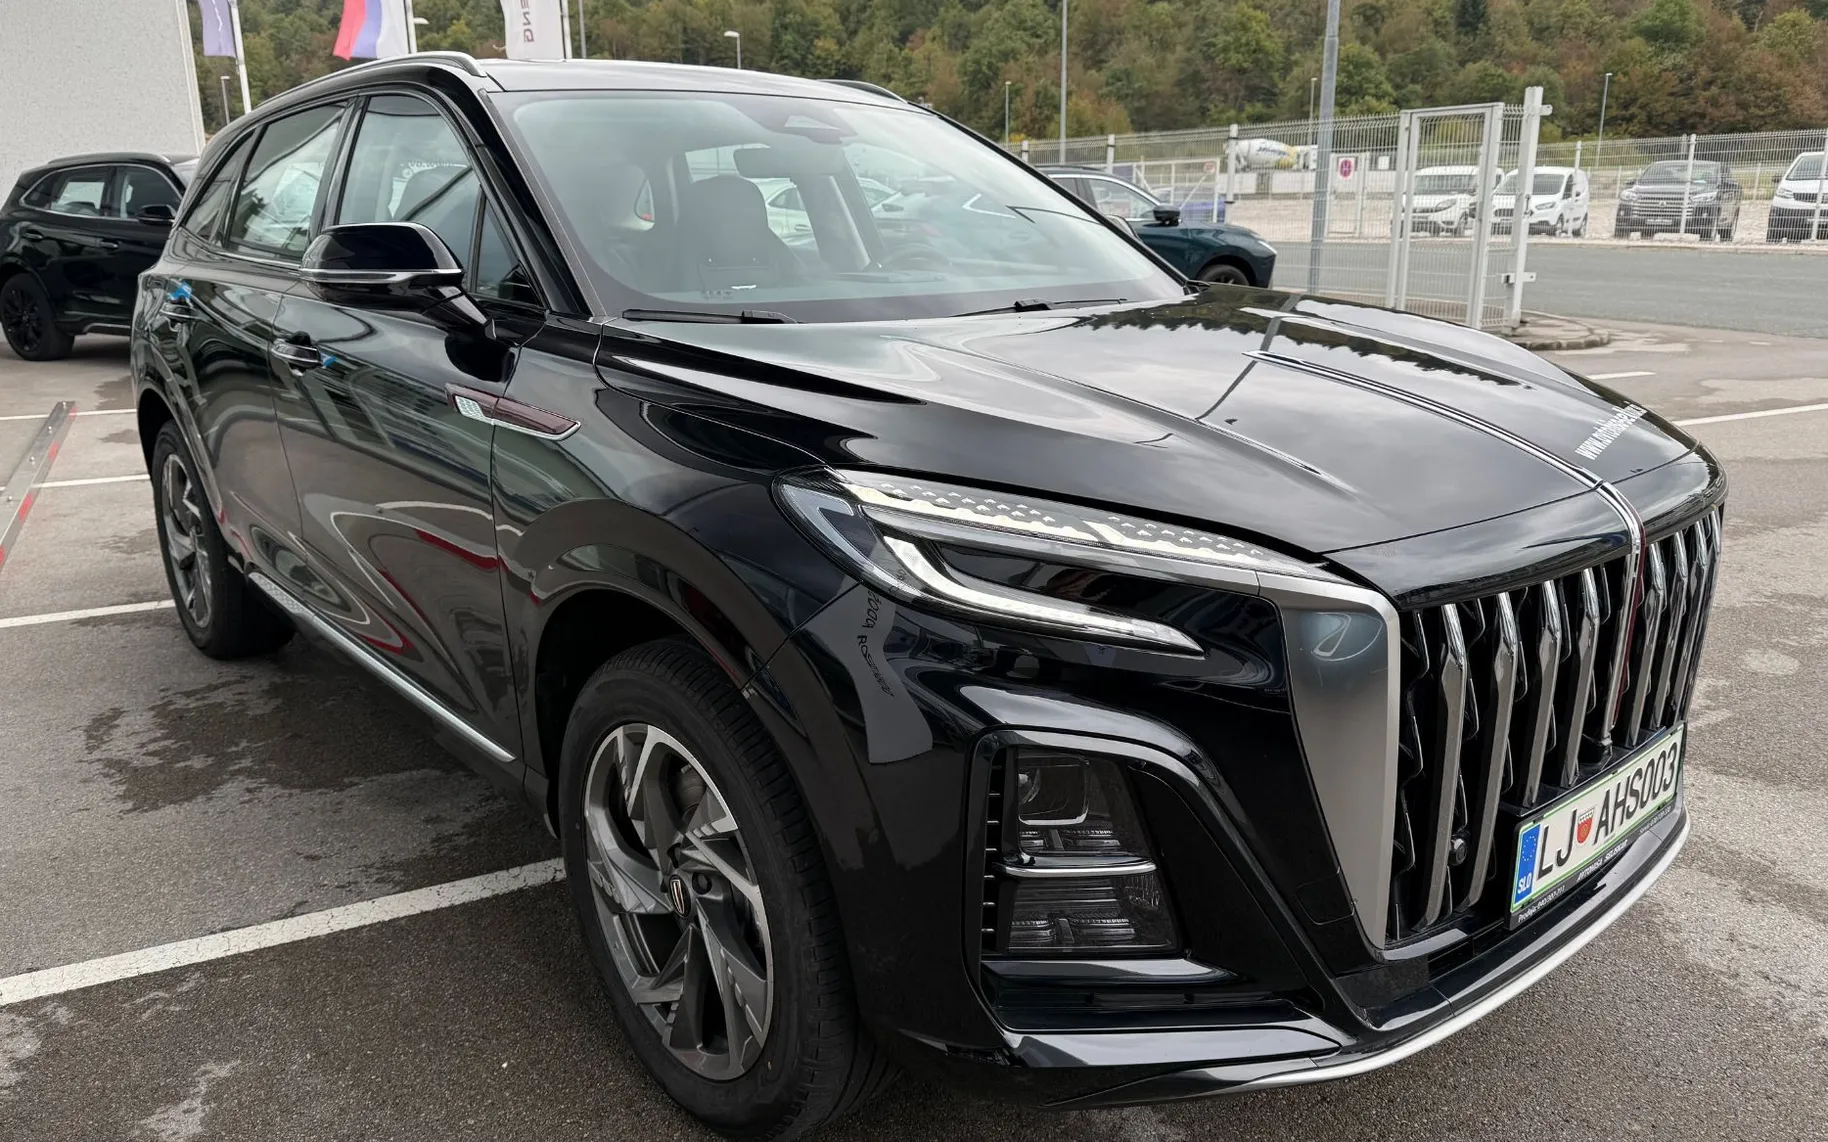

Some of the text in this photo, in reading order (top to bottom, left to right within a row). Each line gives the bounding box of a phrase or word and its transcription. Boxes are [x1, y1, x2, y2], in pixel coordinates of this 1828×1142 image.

[1537, 742, 1677, 880] LJ AHS003
[1517, 873, 1532, 894] SLO
